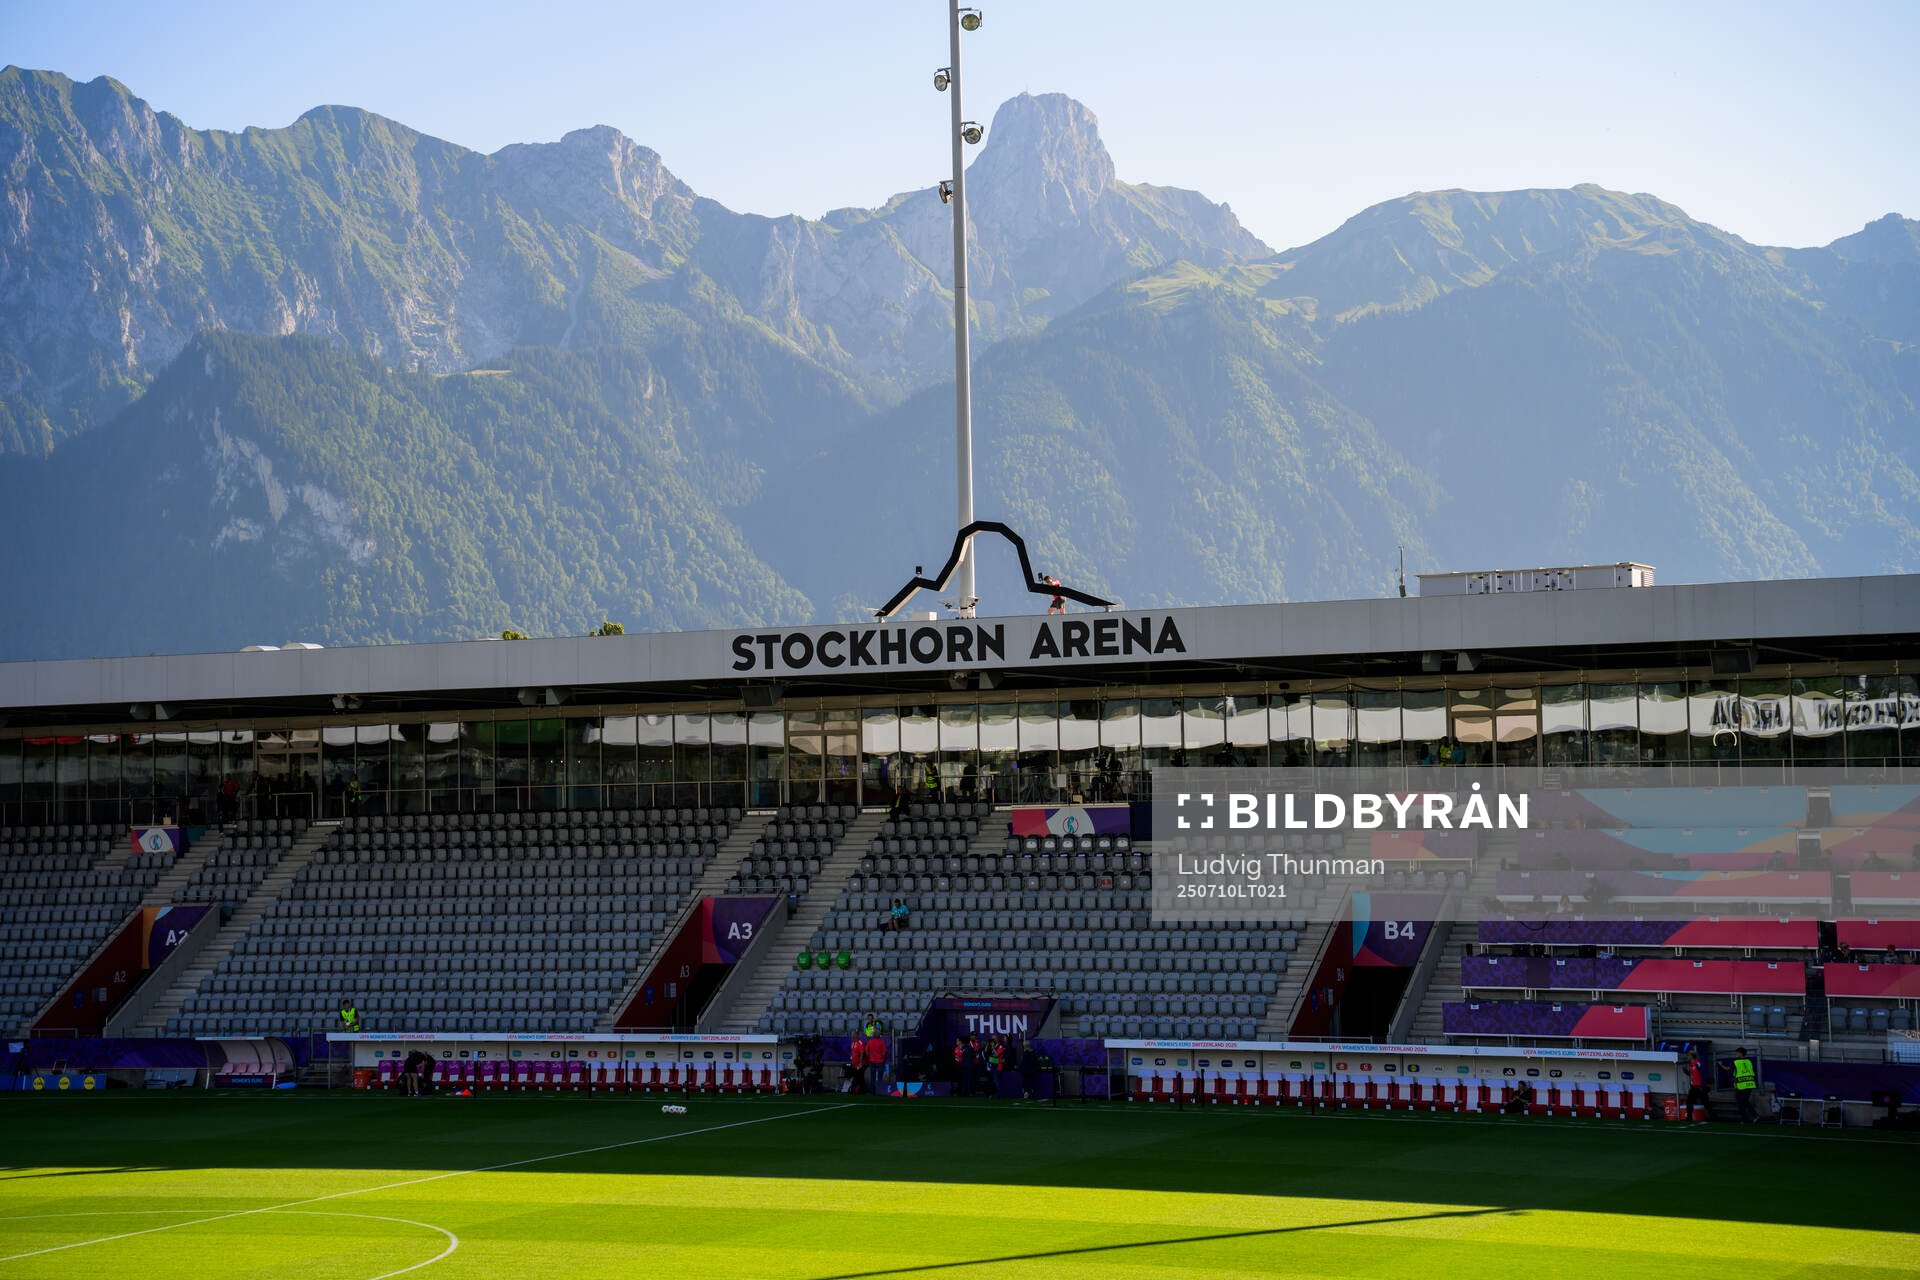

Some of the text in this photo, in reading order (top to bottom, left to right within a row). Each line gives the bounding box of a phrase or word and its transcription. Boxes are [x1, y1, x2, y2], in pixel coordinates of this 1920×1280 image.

[732, 615, 1187, 671] STOCKHORN ARENA
[727, 922, 753, 940] A3
[1384, 921, 1416, 940] B4
[113, 970, 127, 983] A2
[964, 1014, 1028, 1034] THUN
